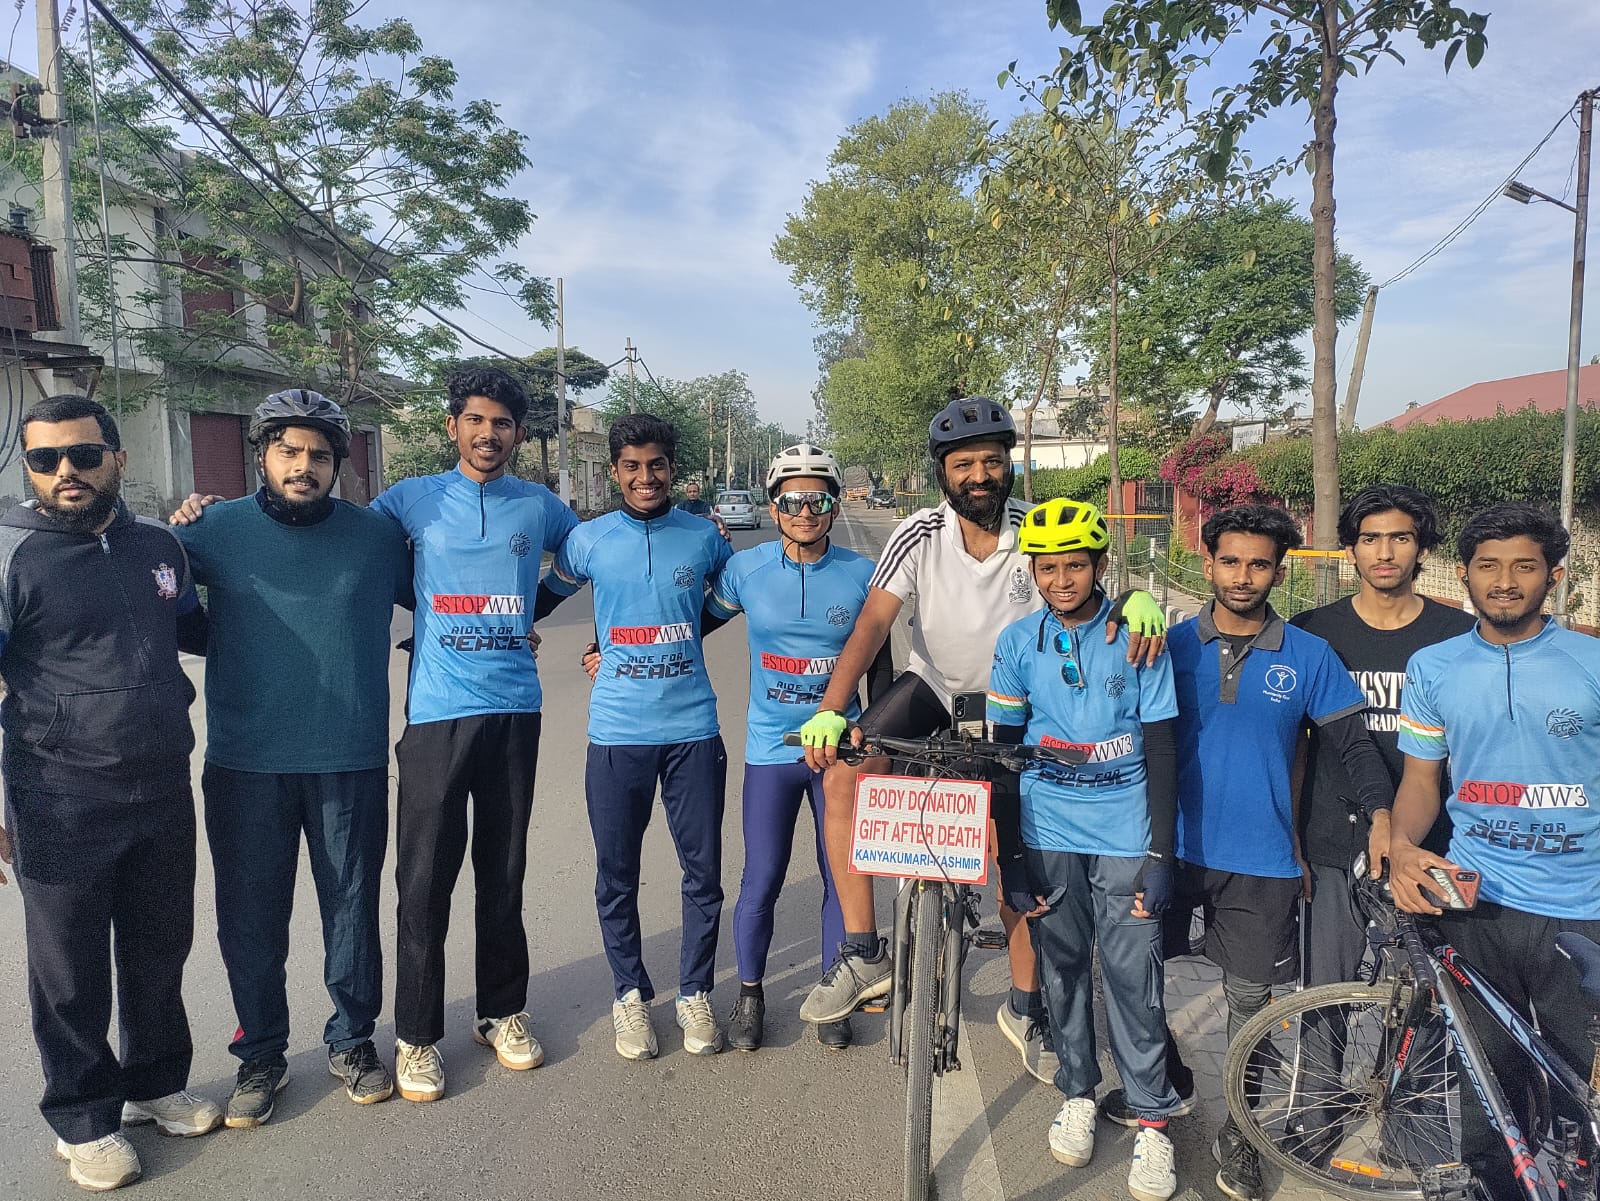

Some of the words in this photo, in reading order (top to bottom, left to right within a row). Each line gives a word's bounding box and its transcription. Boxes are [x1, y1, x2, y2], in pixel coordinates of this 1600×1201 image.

[433, 596, 524, 614] #STOPWW
[451, 626, 482, 635] RIDE
[488, 626, 514, 635] FOR
[440, 634, 527, 652] PEACE
[627, 655, 655, 664] RIDE
[661, 652, 683, 663] FOR
[615, 659, 694, 679] PEACE
[766, 687, 825, 705] PEAC
[776, 681, 803, 692] RIDE
[868, 788, 905, 810] BODY
[908, 790, 977, 815] DONATION
[1458, 782, 1588, 807] #STOPWW3
[859, 819, 889, 841] GIFT
[891, 822, 934, 845] AFTER
[937, 824, 982, 848] DEATH
[1480, 818, 1520, 832] RIDE
[1530, 822, 1566, 833] FOR
[1464, 823, 1586, 854] PEACE
[855, 849, 981, 871] KANYAKUMARI-KASHMIR
[1442, 958, 1472, 986] SPIRIT
